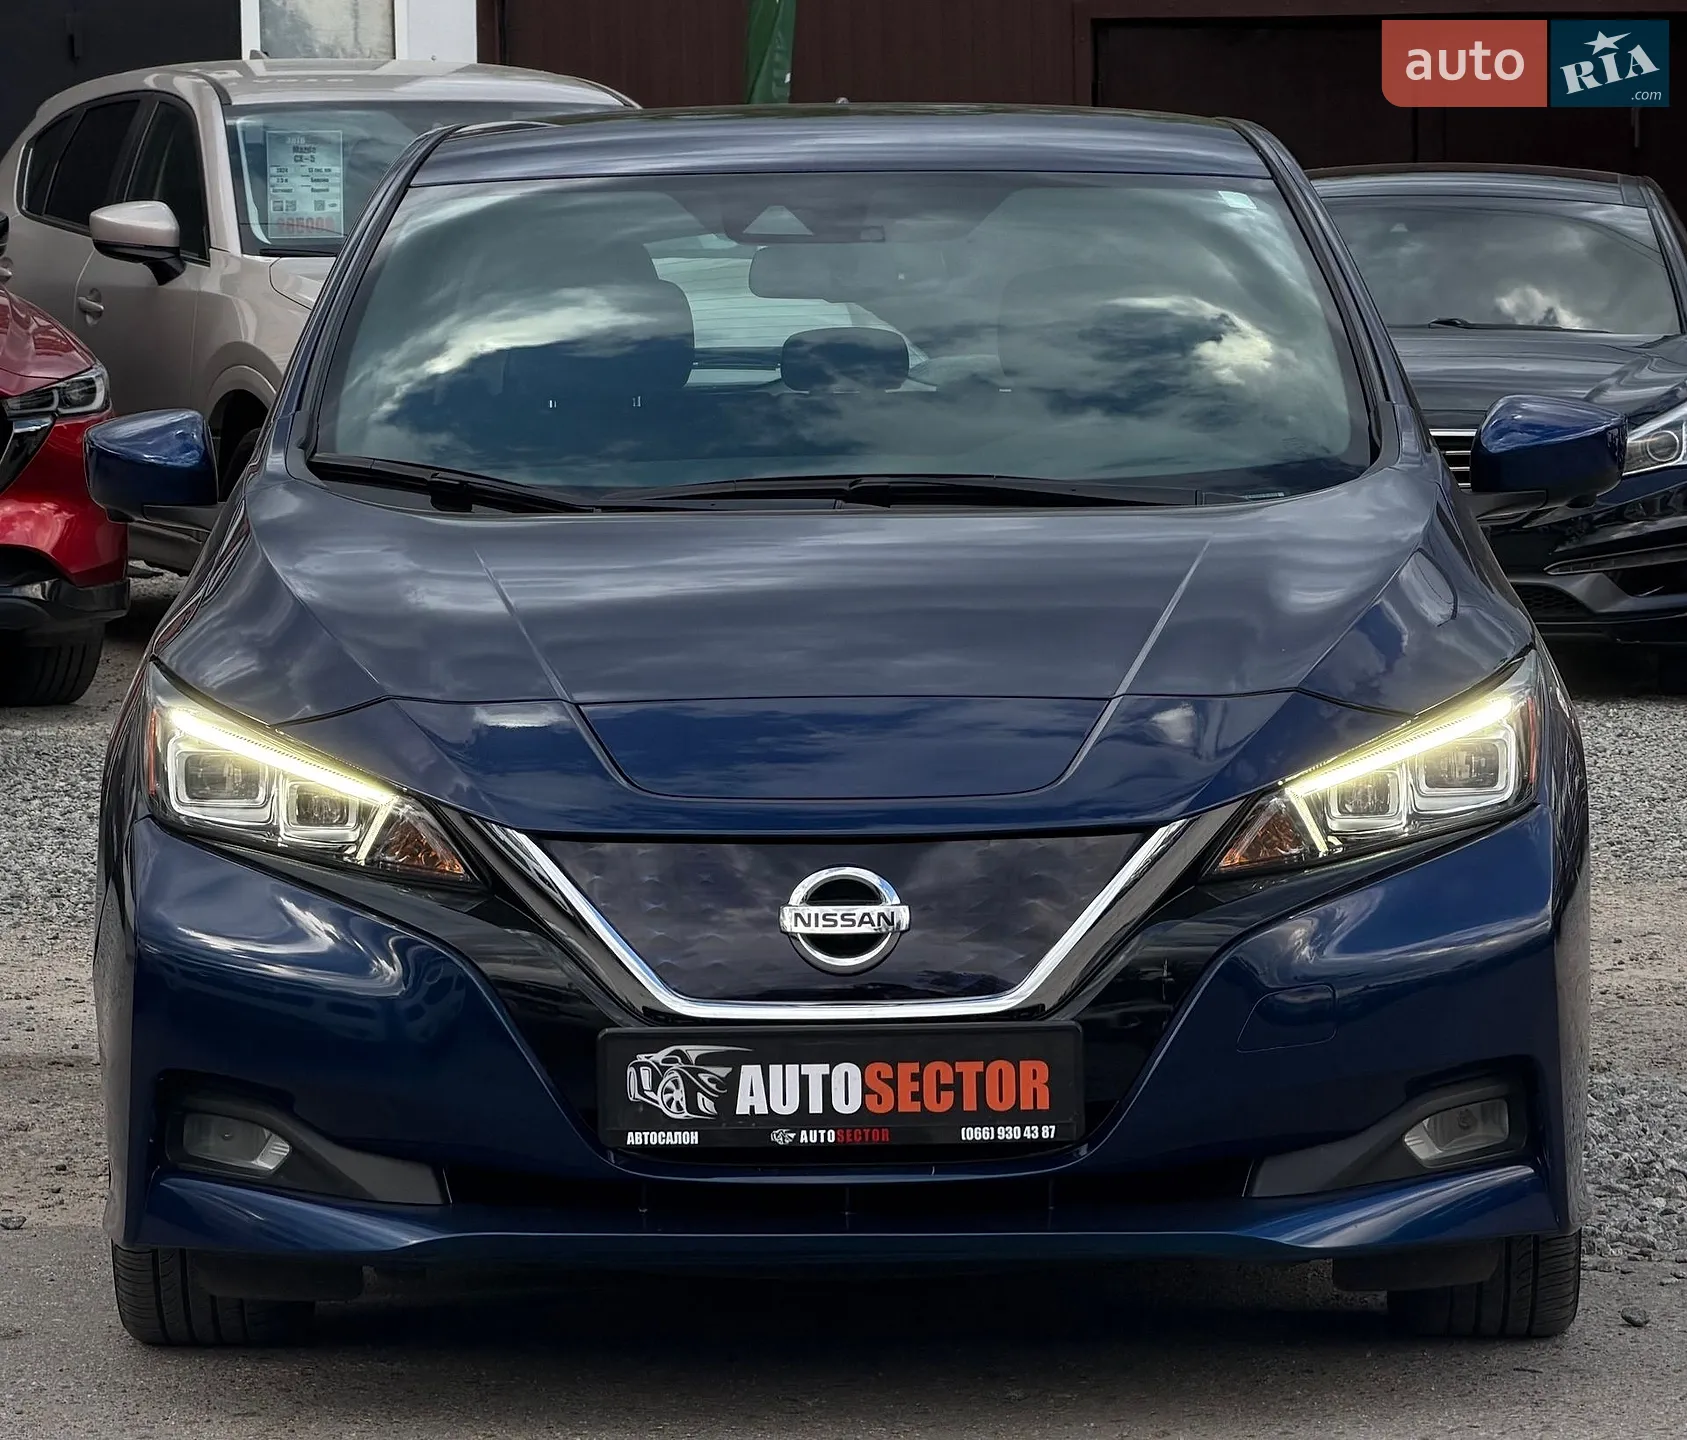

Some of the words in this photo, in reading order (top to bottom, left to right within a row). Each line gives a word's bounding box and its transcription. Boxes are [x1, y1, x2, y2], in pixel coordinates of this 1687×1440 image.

[793, 911, 895, 928] NISSAN
[735, 1060, 1050, 1115] AUTOSECTOR
[626, 1131, 699, 1145] АВТОСАЛОН
[799, 1127, 891, 1144] AUTOSECTOR
[961, 1126, 995, 1141] (066)
[997, 1125, 1021, 1140] 930
[1023, 1125, 1039, 1139] 43
[1041, 1125, 1056, 1139] 87
